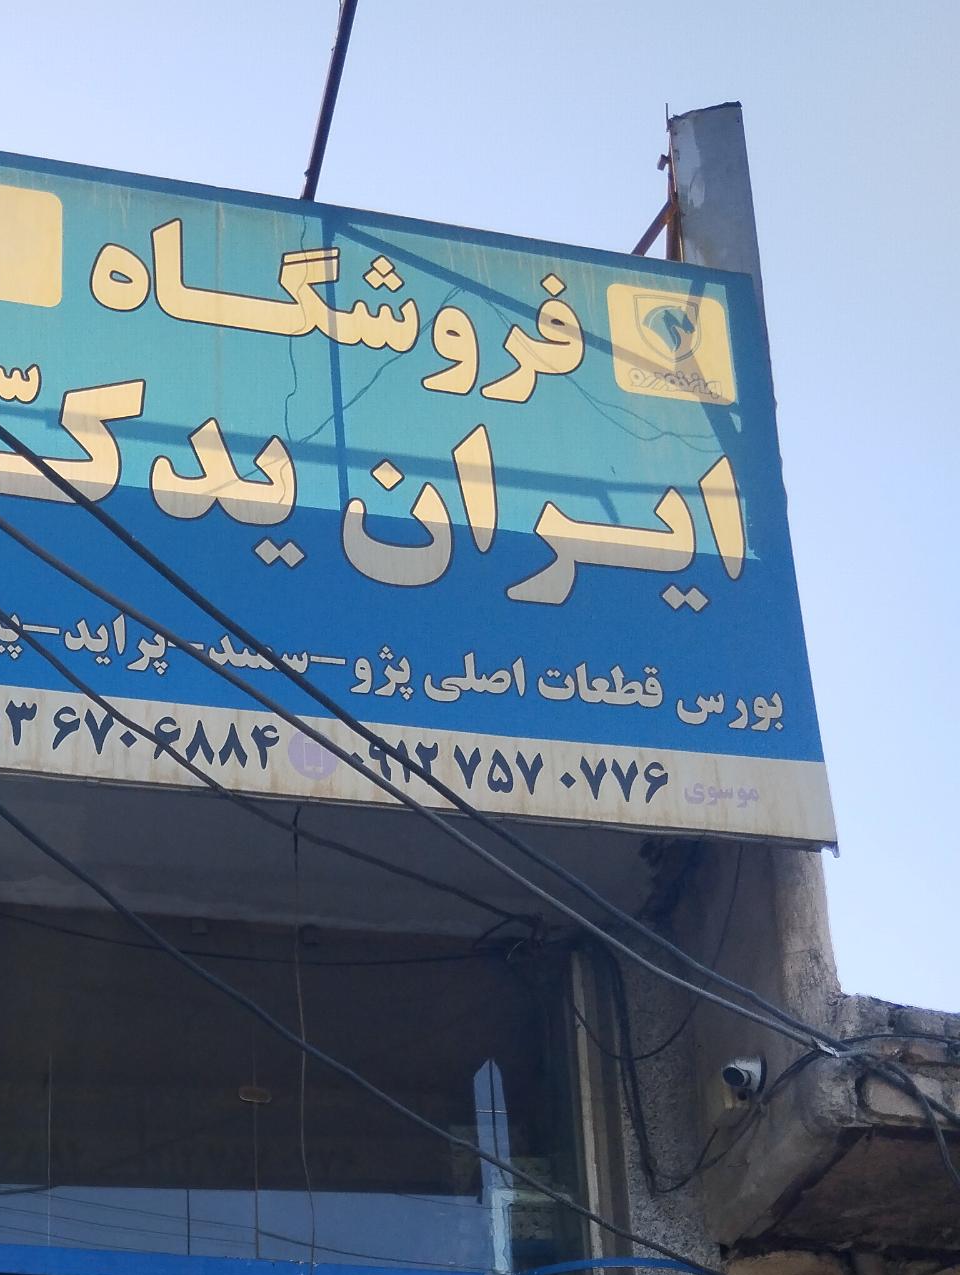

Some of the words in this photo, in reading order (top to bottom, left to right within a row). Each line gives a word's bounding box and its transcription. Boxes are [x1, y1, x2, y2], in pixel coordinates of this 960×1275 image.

[89, 218, 586, 404] فروشگاه
[340, 423, 749, 613] ایران
[424, 650, 527, 703] اصلی
[537, 660, 664, 708] قطعات
[676, 690, 784, 732] بورس
[683, 781, 760, 804] موسوی
